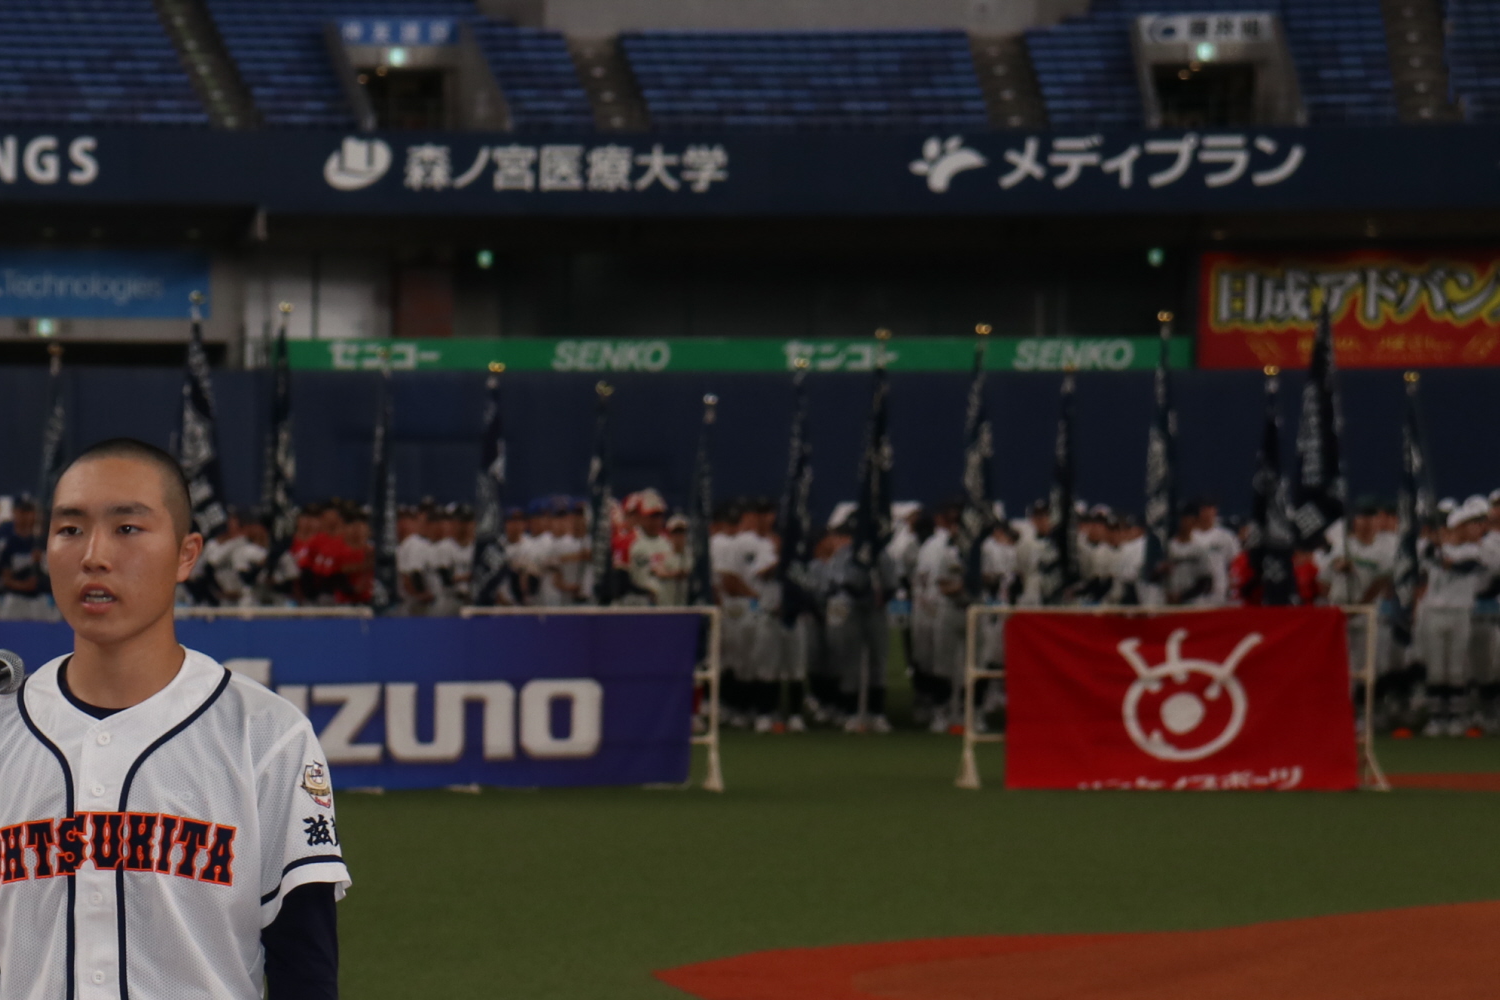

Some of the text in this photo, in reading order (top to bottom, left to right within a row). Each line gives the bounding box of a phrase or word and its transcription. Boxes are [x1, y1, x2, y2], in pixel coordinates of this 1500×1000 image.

[402, 141, 730, 194] 森ノ宮医療大学
[996, 132, 1307, 191] メディプラン
[5, 268, 165, 306] Technologies
[1215, 266, 1500, 323] 日成アドバン
[328, 341, 442, 370] センコー
[552, 341, 672, 373] SENKO
[1011, 340, 1135, 371] SENKO
